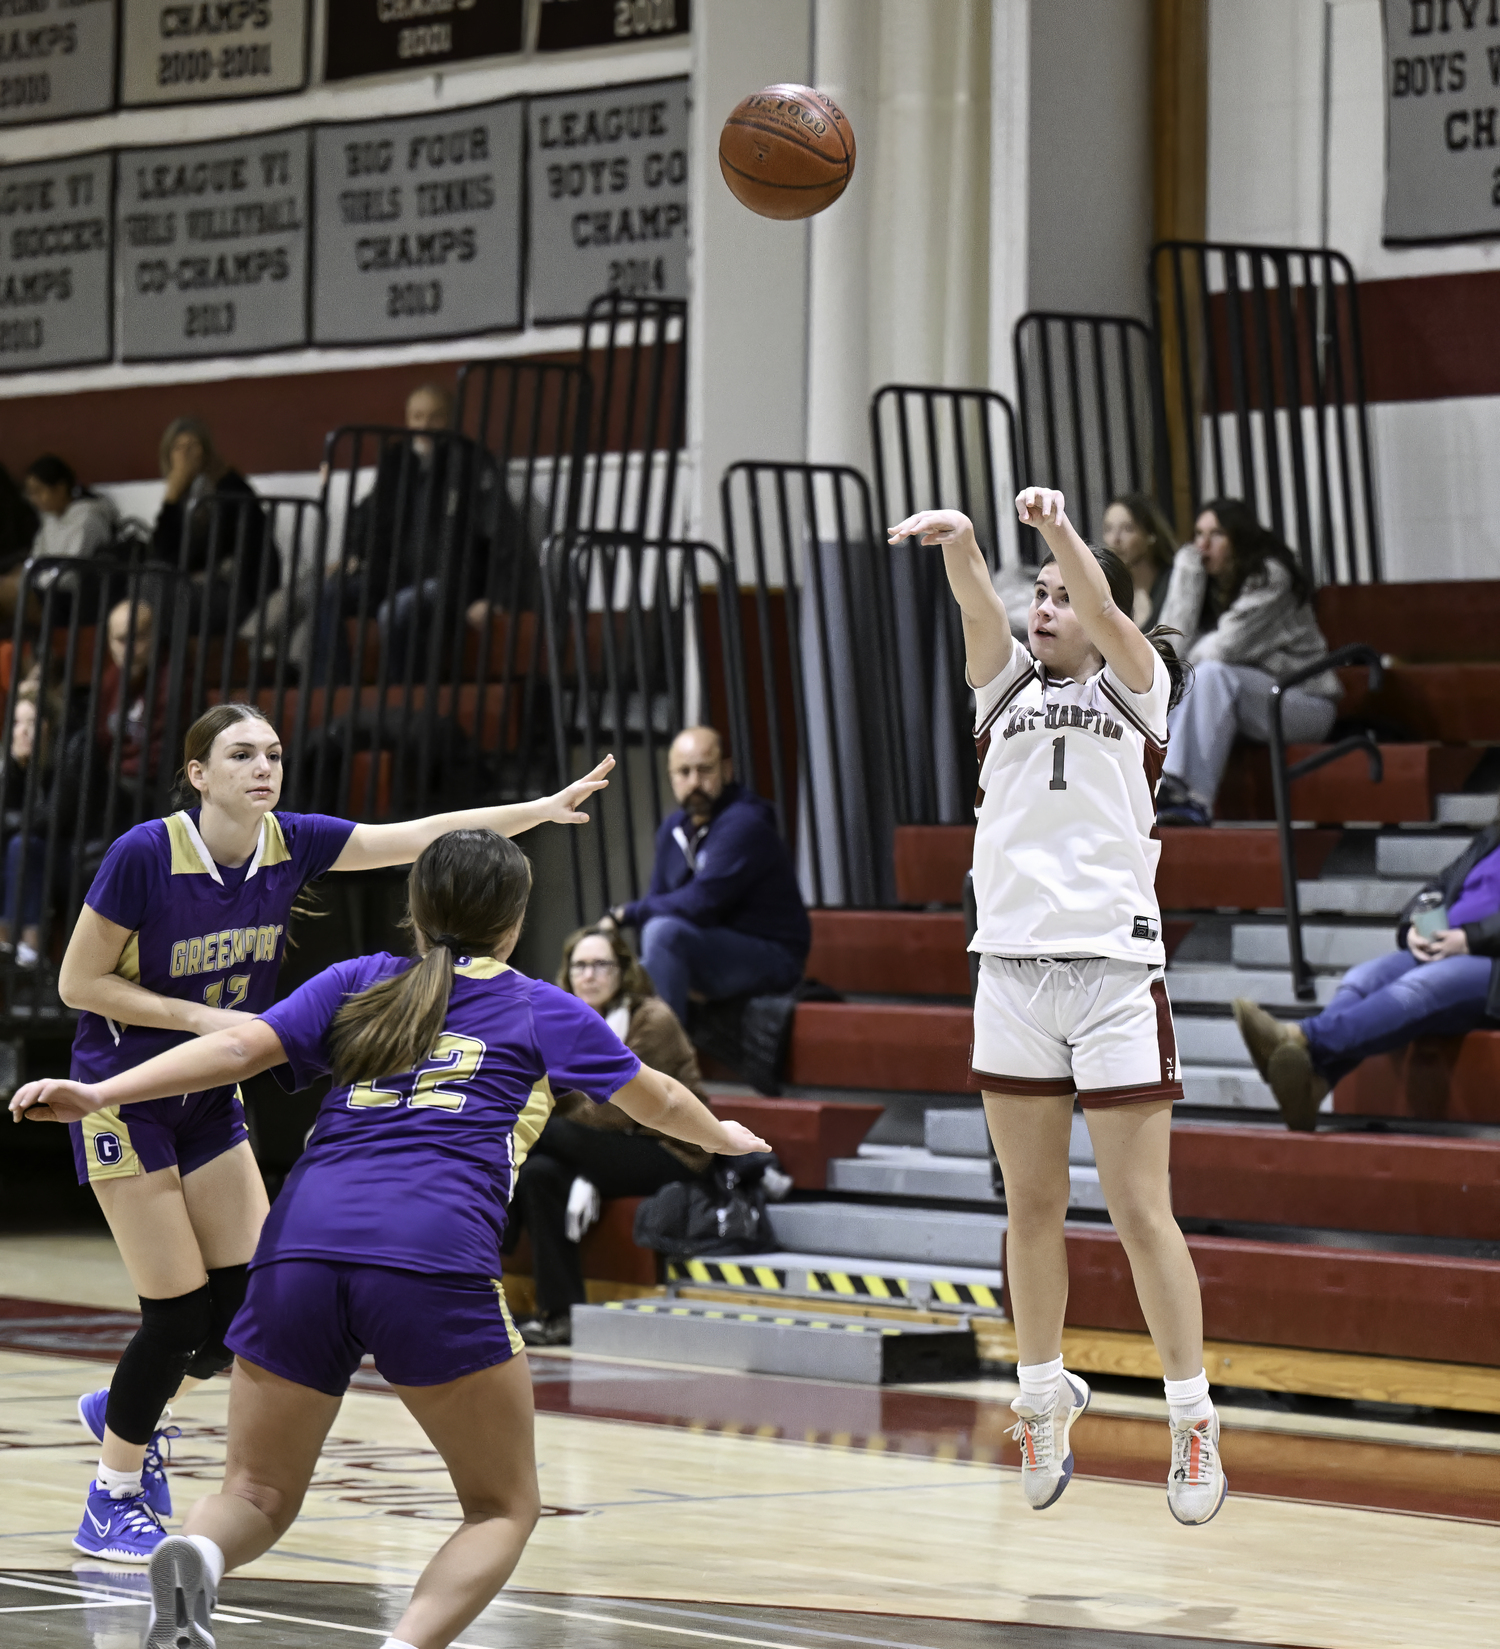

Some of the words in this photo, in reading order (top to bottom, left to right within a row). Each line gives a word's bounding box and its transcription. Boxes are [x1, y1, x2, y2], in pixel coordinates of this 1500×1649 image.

[159, 0, 271, 39] CHAMPS
[1393, 51, 1466, 97] BOYS
[539, 102, 667, 150] LEAGUE
[345, 138, 394, 178] BIG
[406, 125, 489, 171] FOUR
[136, 156, 248, 201] LEAGUE
[414, 173, 496, 219] TENNIS
[547, 155, 630, 200] BOYS
[10, 217, 106, 261] SOCCER
[184, 198, 303, 243] VOLLEYBALL
[134, 247, 291, 294] CO-CHAMPS
[355, 226, 478, 274] CHAMPS
[183, 301, 236, 340] 2013
[386, 279, 442, 318] 2013
[1044, 703, 1124, 741] HAMPTON
[1049, 735, 1068, 791] 1
